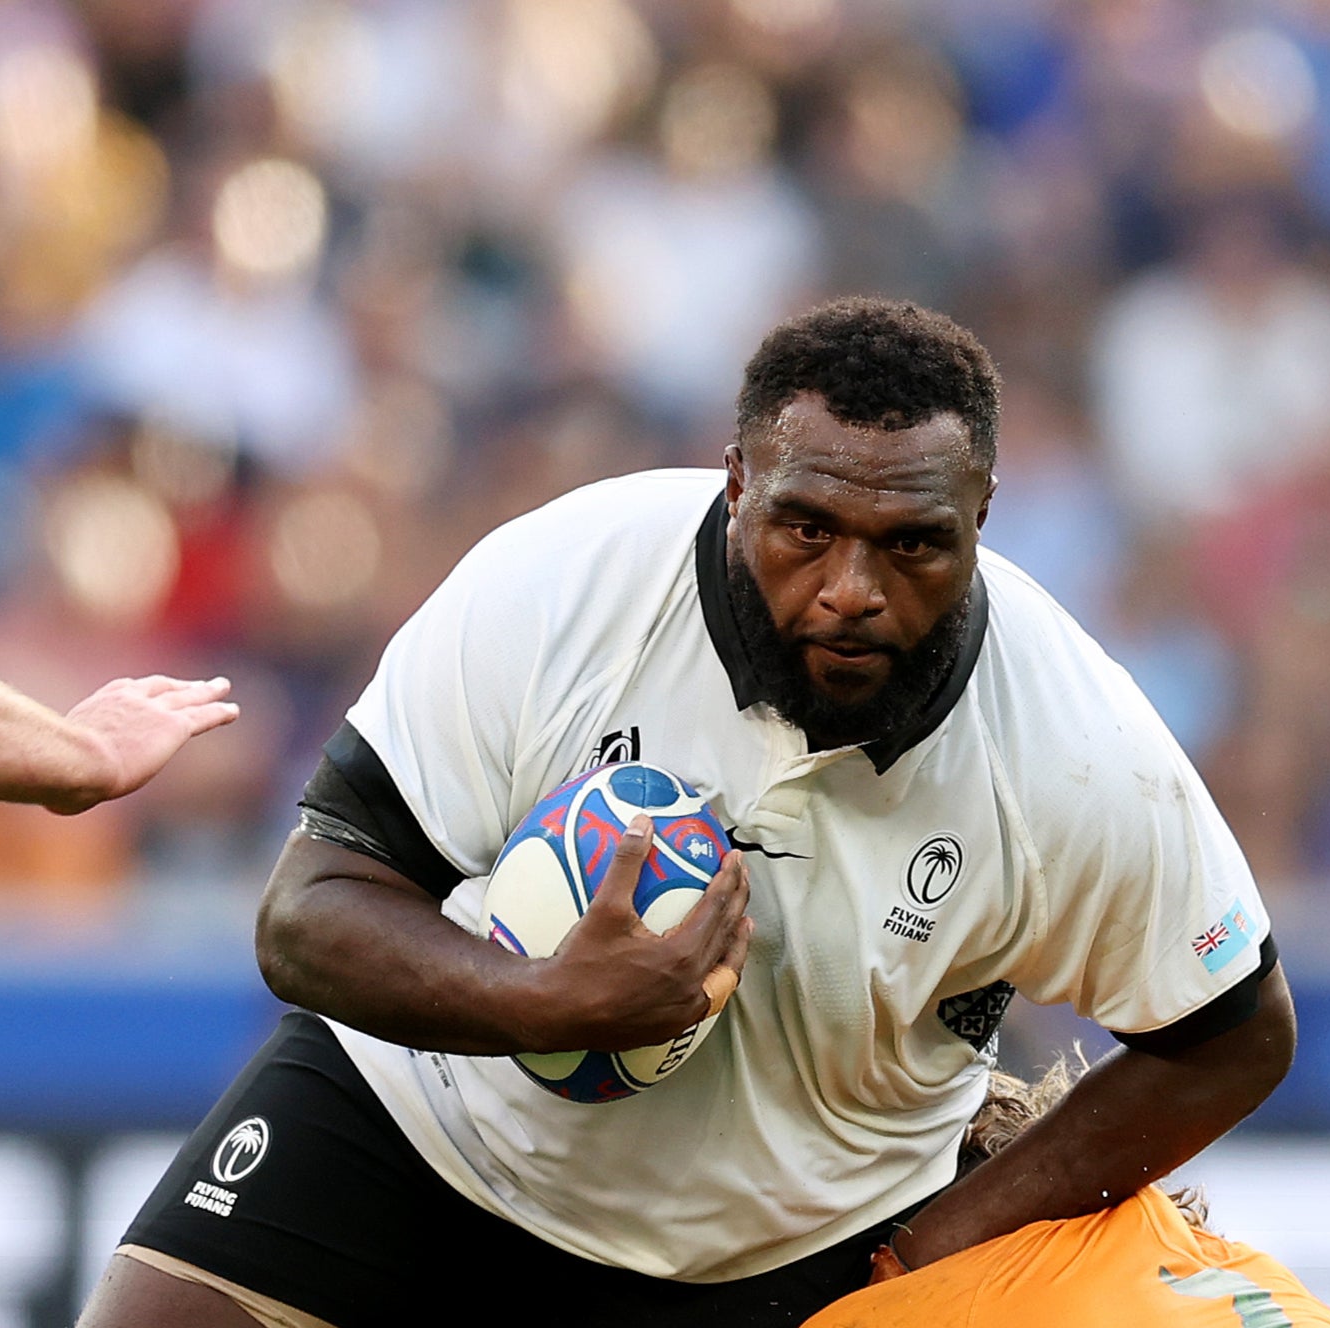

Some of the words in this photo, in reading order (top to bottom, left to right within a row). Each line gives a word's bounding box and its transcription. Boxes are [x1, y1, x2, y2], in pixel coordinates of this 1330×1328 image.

[883, 919, 931, 943] FIJIANS
[890, 906, 936, 931] FLYING
[184, 1191, 233, 1218] FIJIANS
[192, 1180, 239, 1206] FLYING
